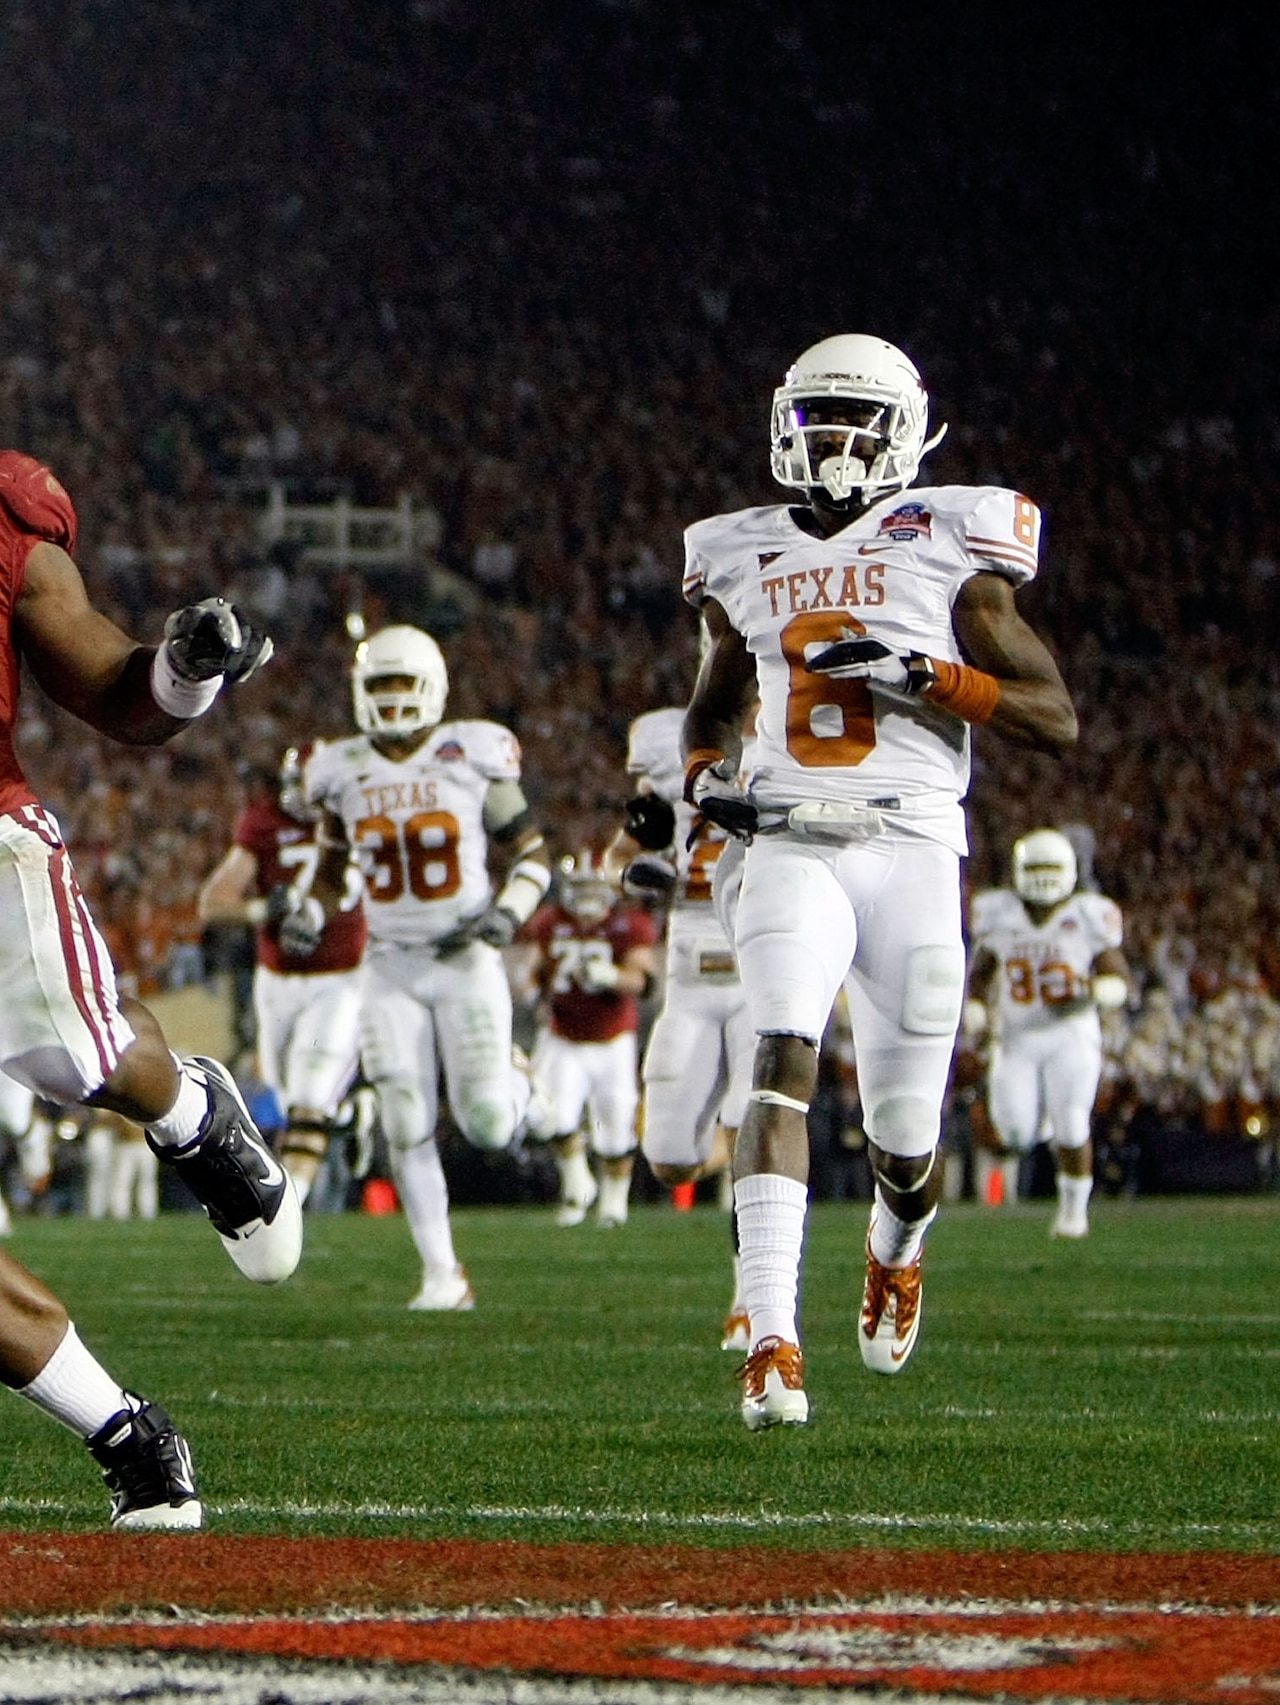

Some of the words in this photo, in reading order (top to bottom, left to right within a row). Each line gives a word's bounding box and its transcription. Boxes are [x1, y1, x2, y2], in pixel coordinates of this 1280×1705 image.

[1013, 493, 1036, 549] 8
[762, 564, 886, 617] TEXAS
[779, 611, 877, 767] 8
[362, 780, 438, 818] TEXAS
[354, 810, 463, 904] 38
